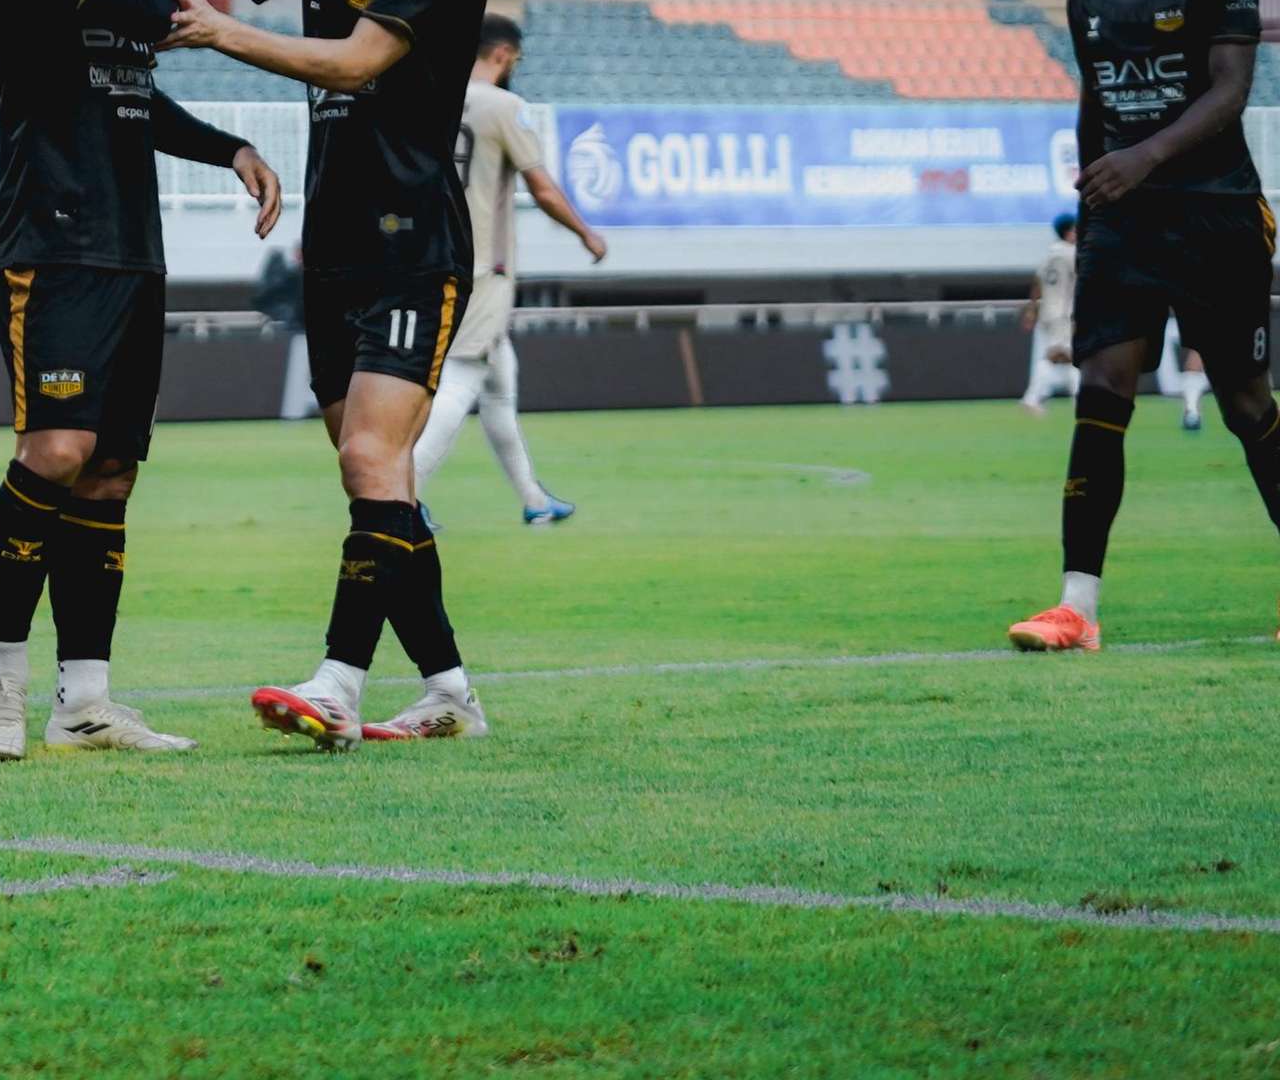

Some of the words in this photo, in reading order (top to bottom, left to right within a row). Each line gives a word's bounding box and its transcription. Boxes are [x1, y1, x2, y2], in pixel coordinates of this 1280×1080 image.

[1093, 52, 1188, 85] BAIC
[388, 308, 417, 349] 11
[1252, 326, 1267, 362] 8
[41, 371, 81, 383] DEWA
